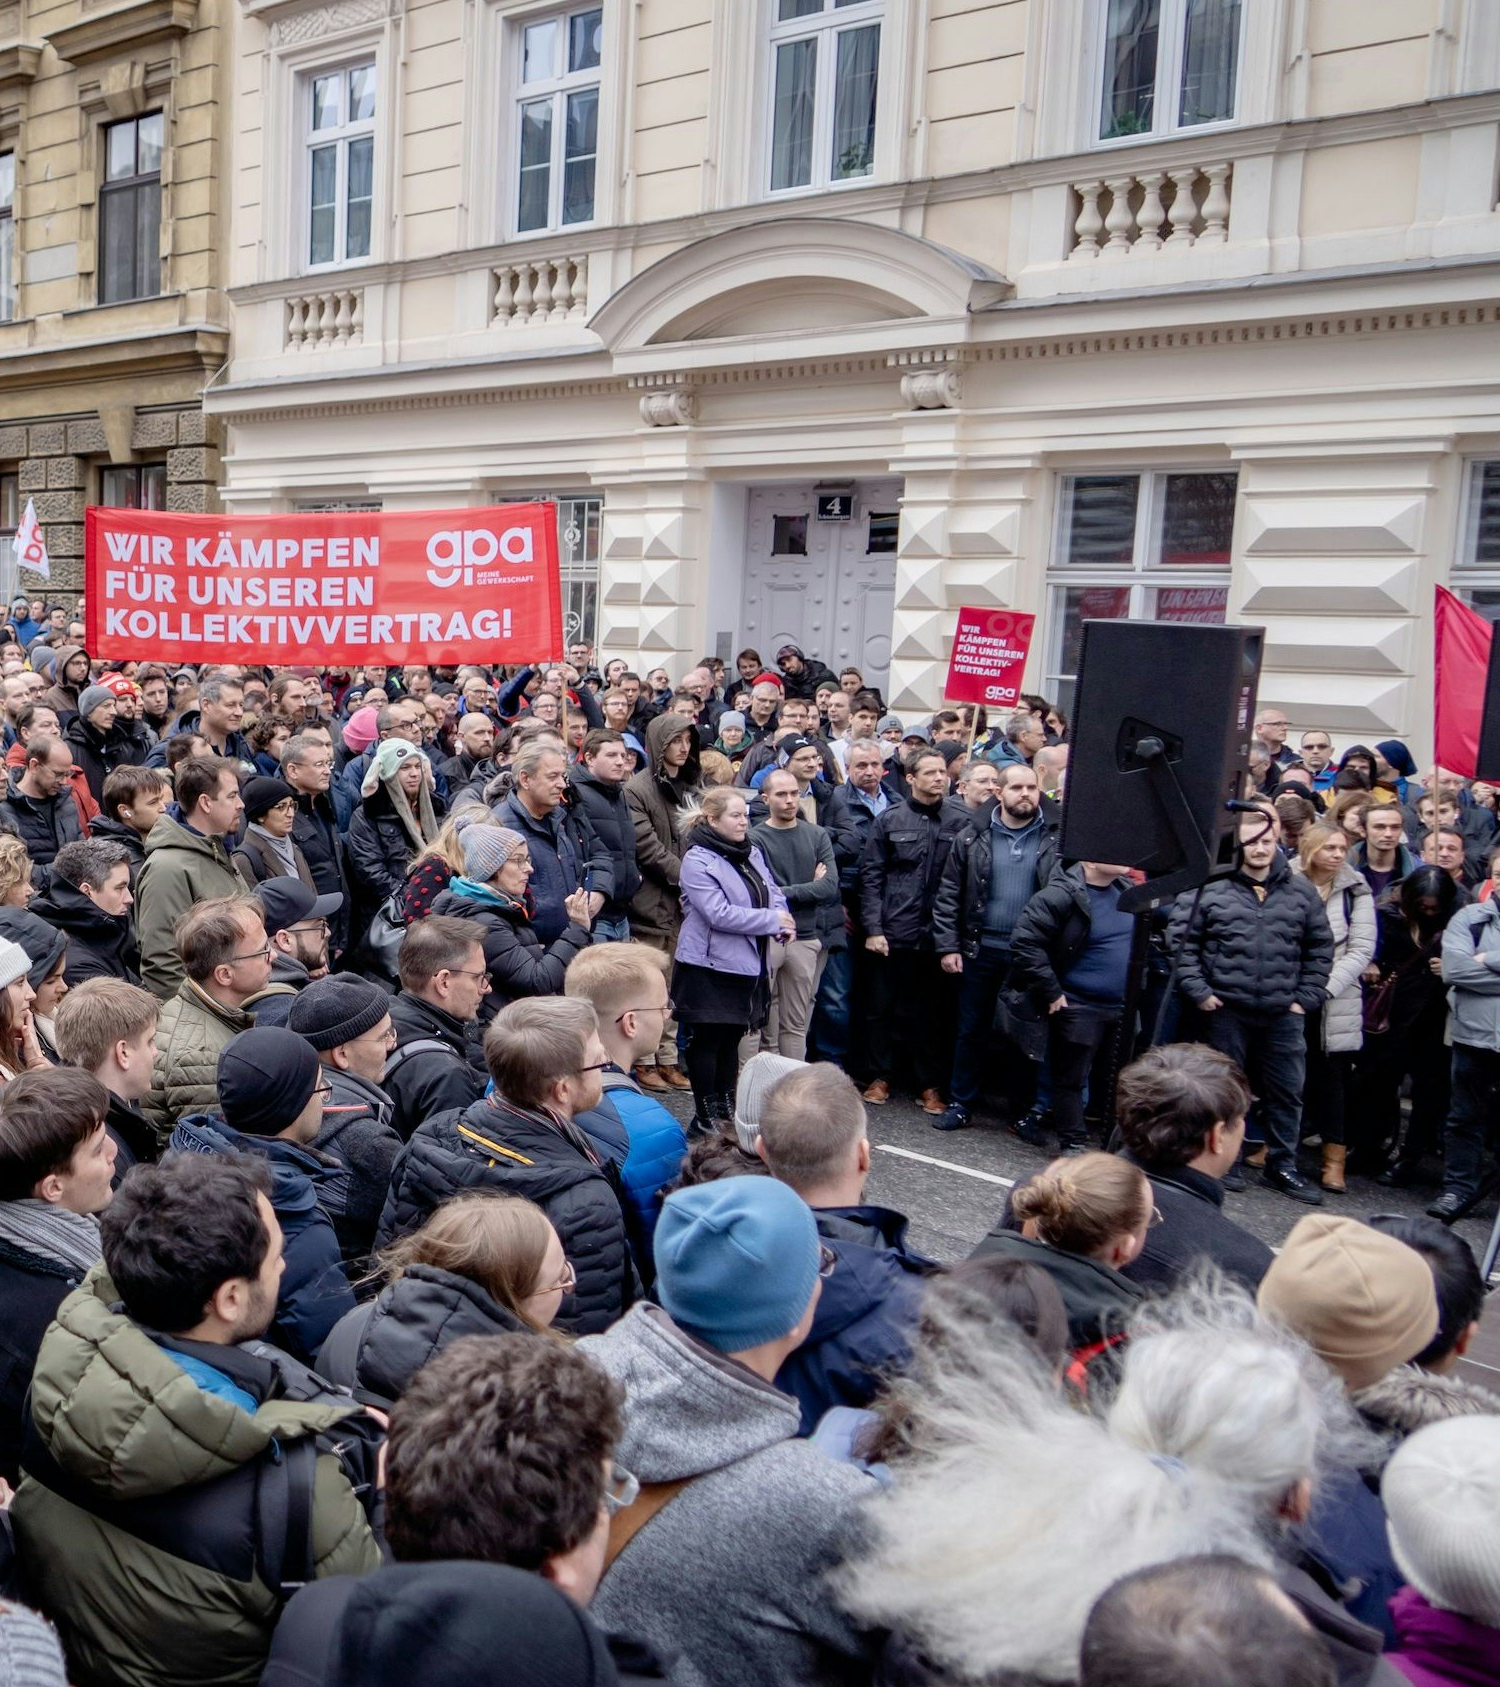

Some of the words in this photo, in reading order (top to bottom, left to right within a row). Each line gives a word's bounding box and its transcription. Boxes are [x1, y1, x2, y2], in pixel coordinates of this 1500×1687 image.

[826, 497, 841, 514] 4
[104, 531, 176, 566] WIR
[186, 531, 380, 568] KÄMPFEN
[426, 526, 534, 588] gpa
[476, 575, 534, 586] GEWERKSCHAFT
[477, 570, 500, 578] MEINE
[106, 566, 176, 604] FÜR
[188, 576, 374, 607] UNSEREN
[106, 608, 512, 644] KOLLEKTIVVERTRAG!
[961, 624, 980, 634] WIR
[958, 634, 1007, 648] KÄMPFEN
[957, 644, 977, 654] FÜR
[978, 647, 1024, 660] UNSEREN
[955, 654, 1012, 668] KOLLEKTIV-
[954, 664, 1001, 677] VERTRAG!
[985, 685, 1016, 700] gpa
